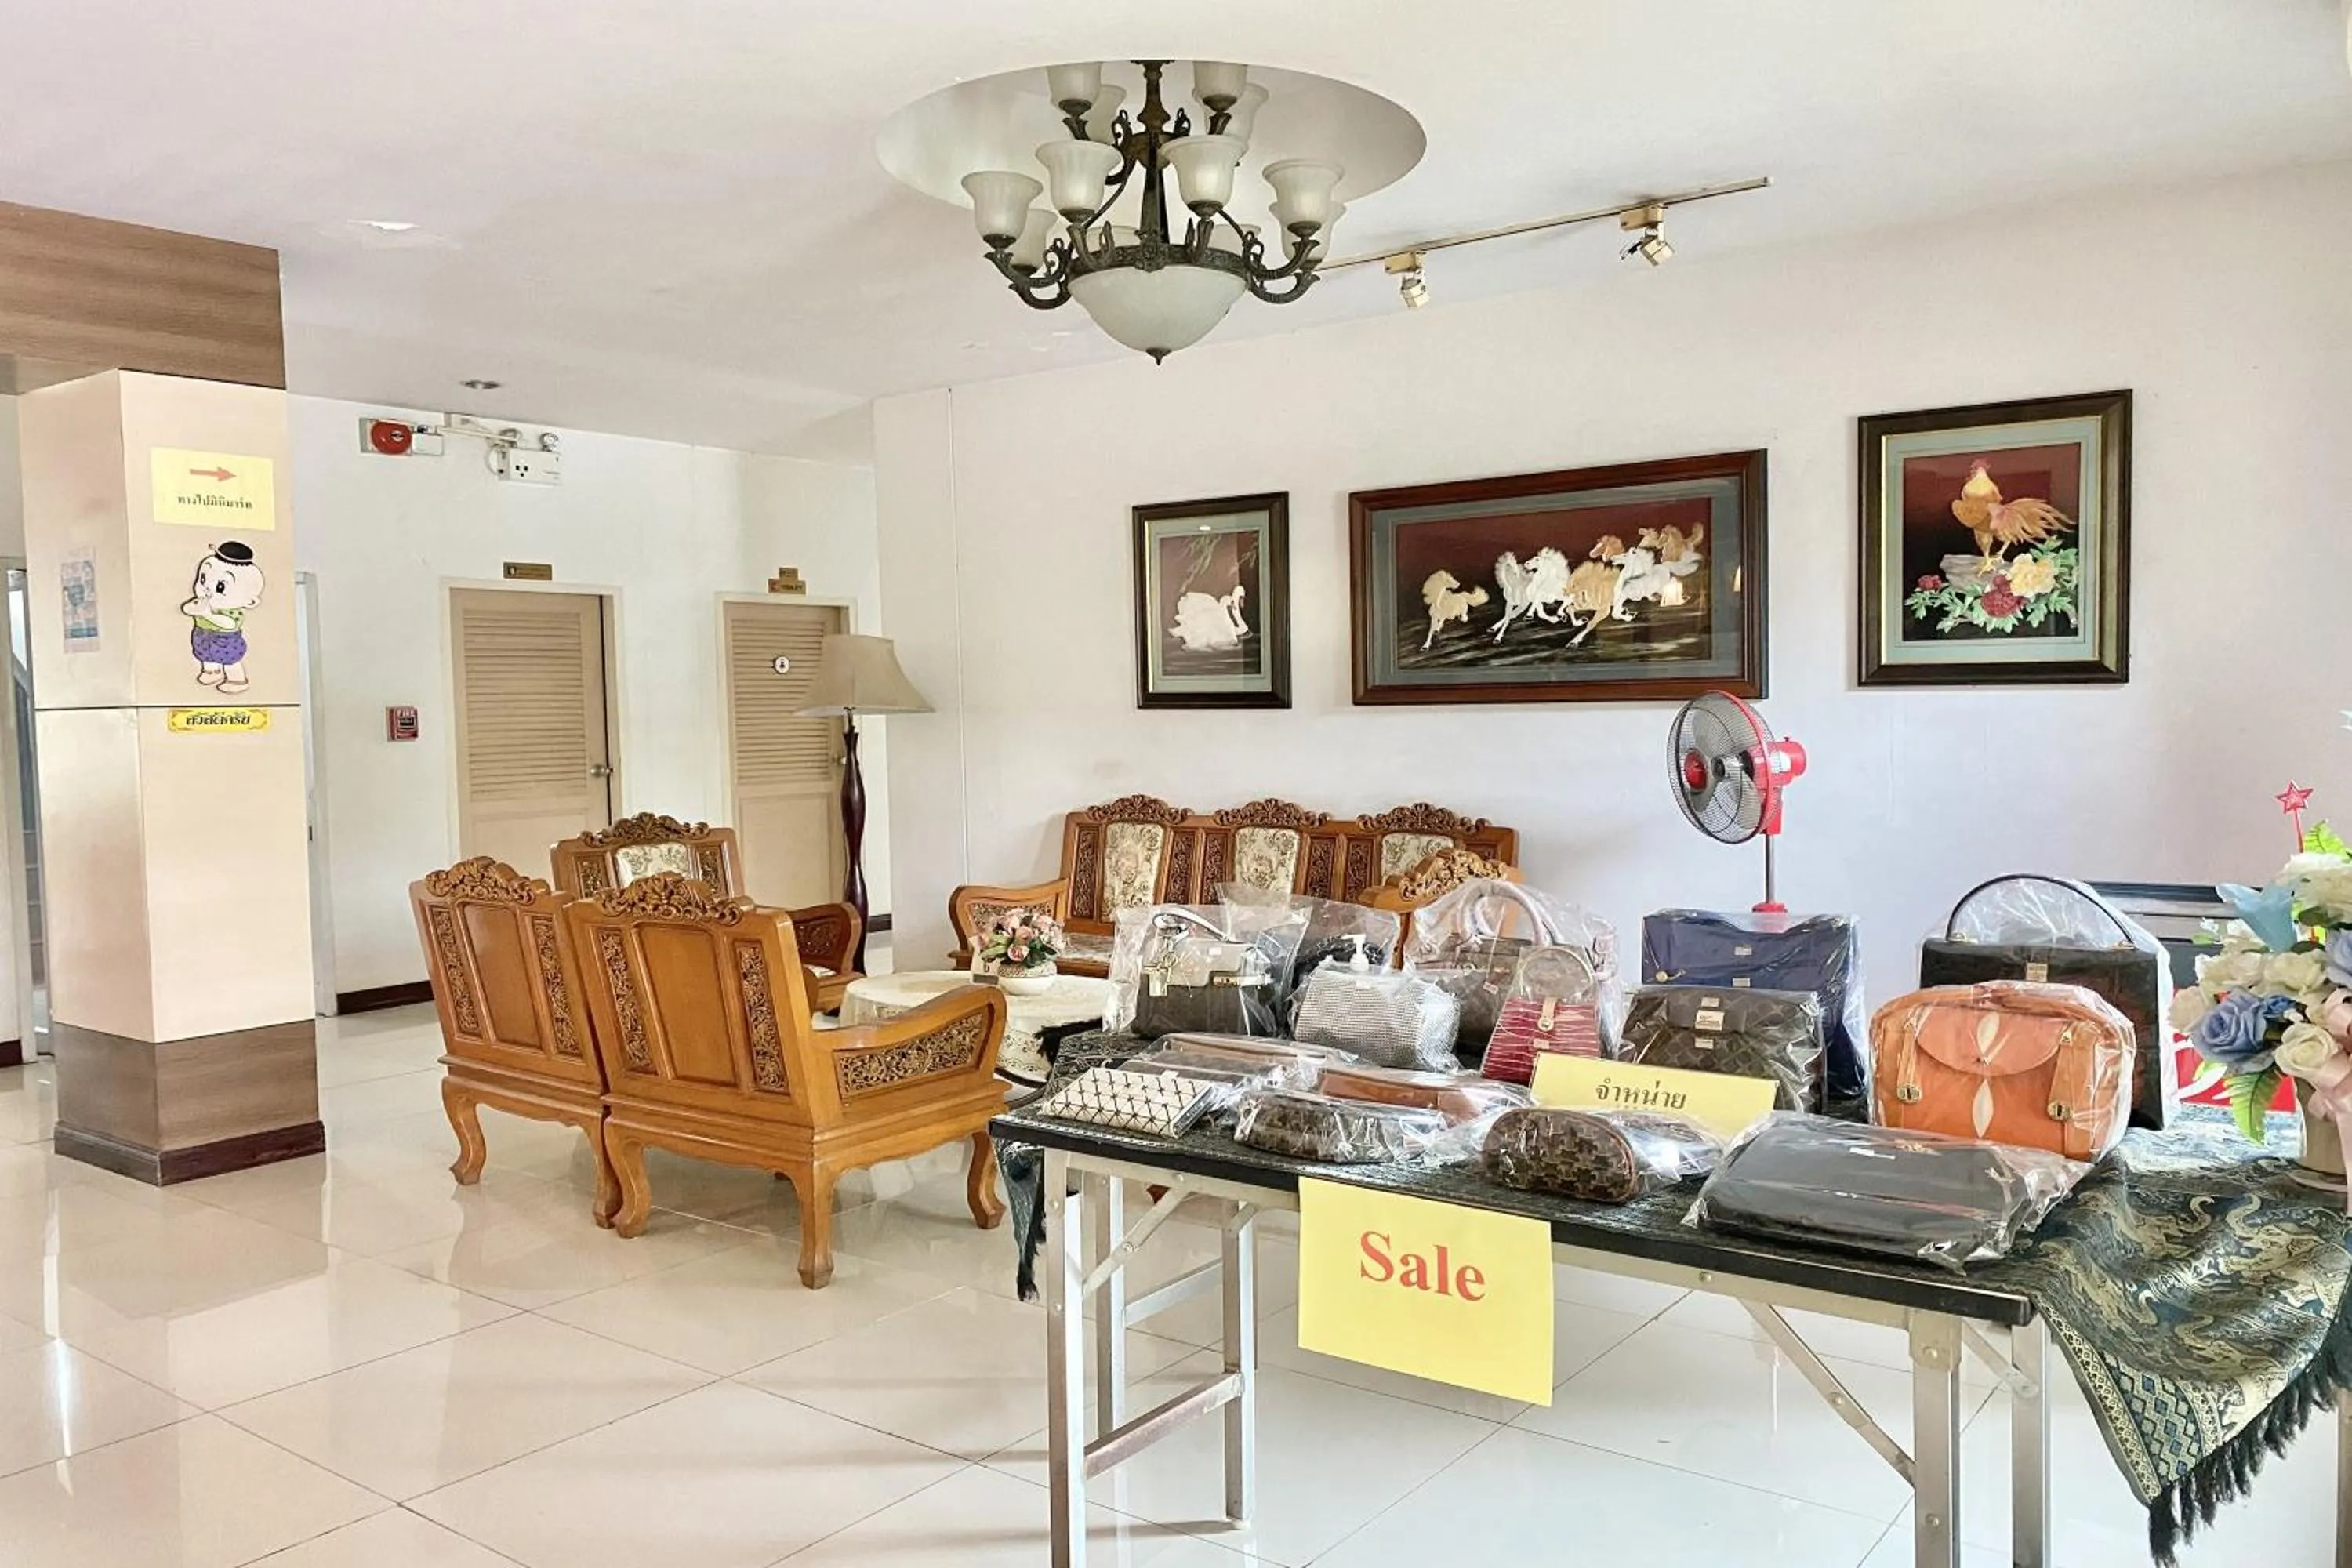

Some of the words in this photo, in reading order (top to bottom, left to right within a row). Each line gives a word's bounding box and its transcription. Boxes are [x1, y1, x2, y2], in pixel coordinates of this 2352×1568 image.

[1595, 1077, 1687, 1109] จำหน่าย
[1360, 1229, 1486, 1302] Sale
